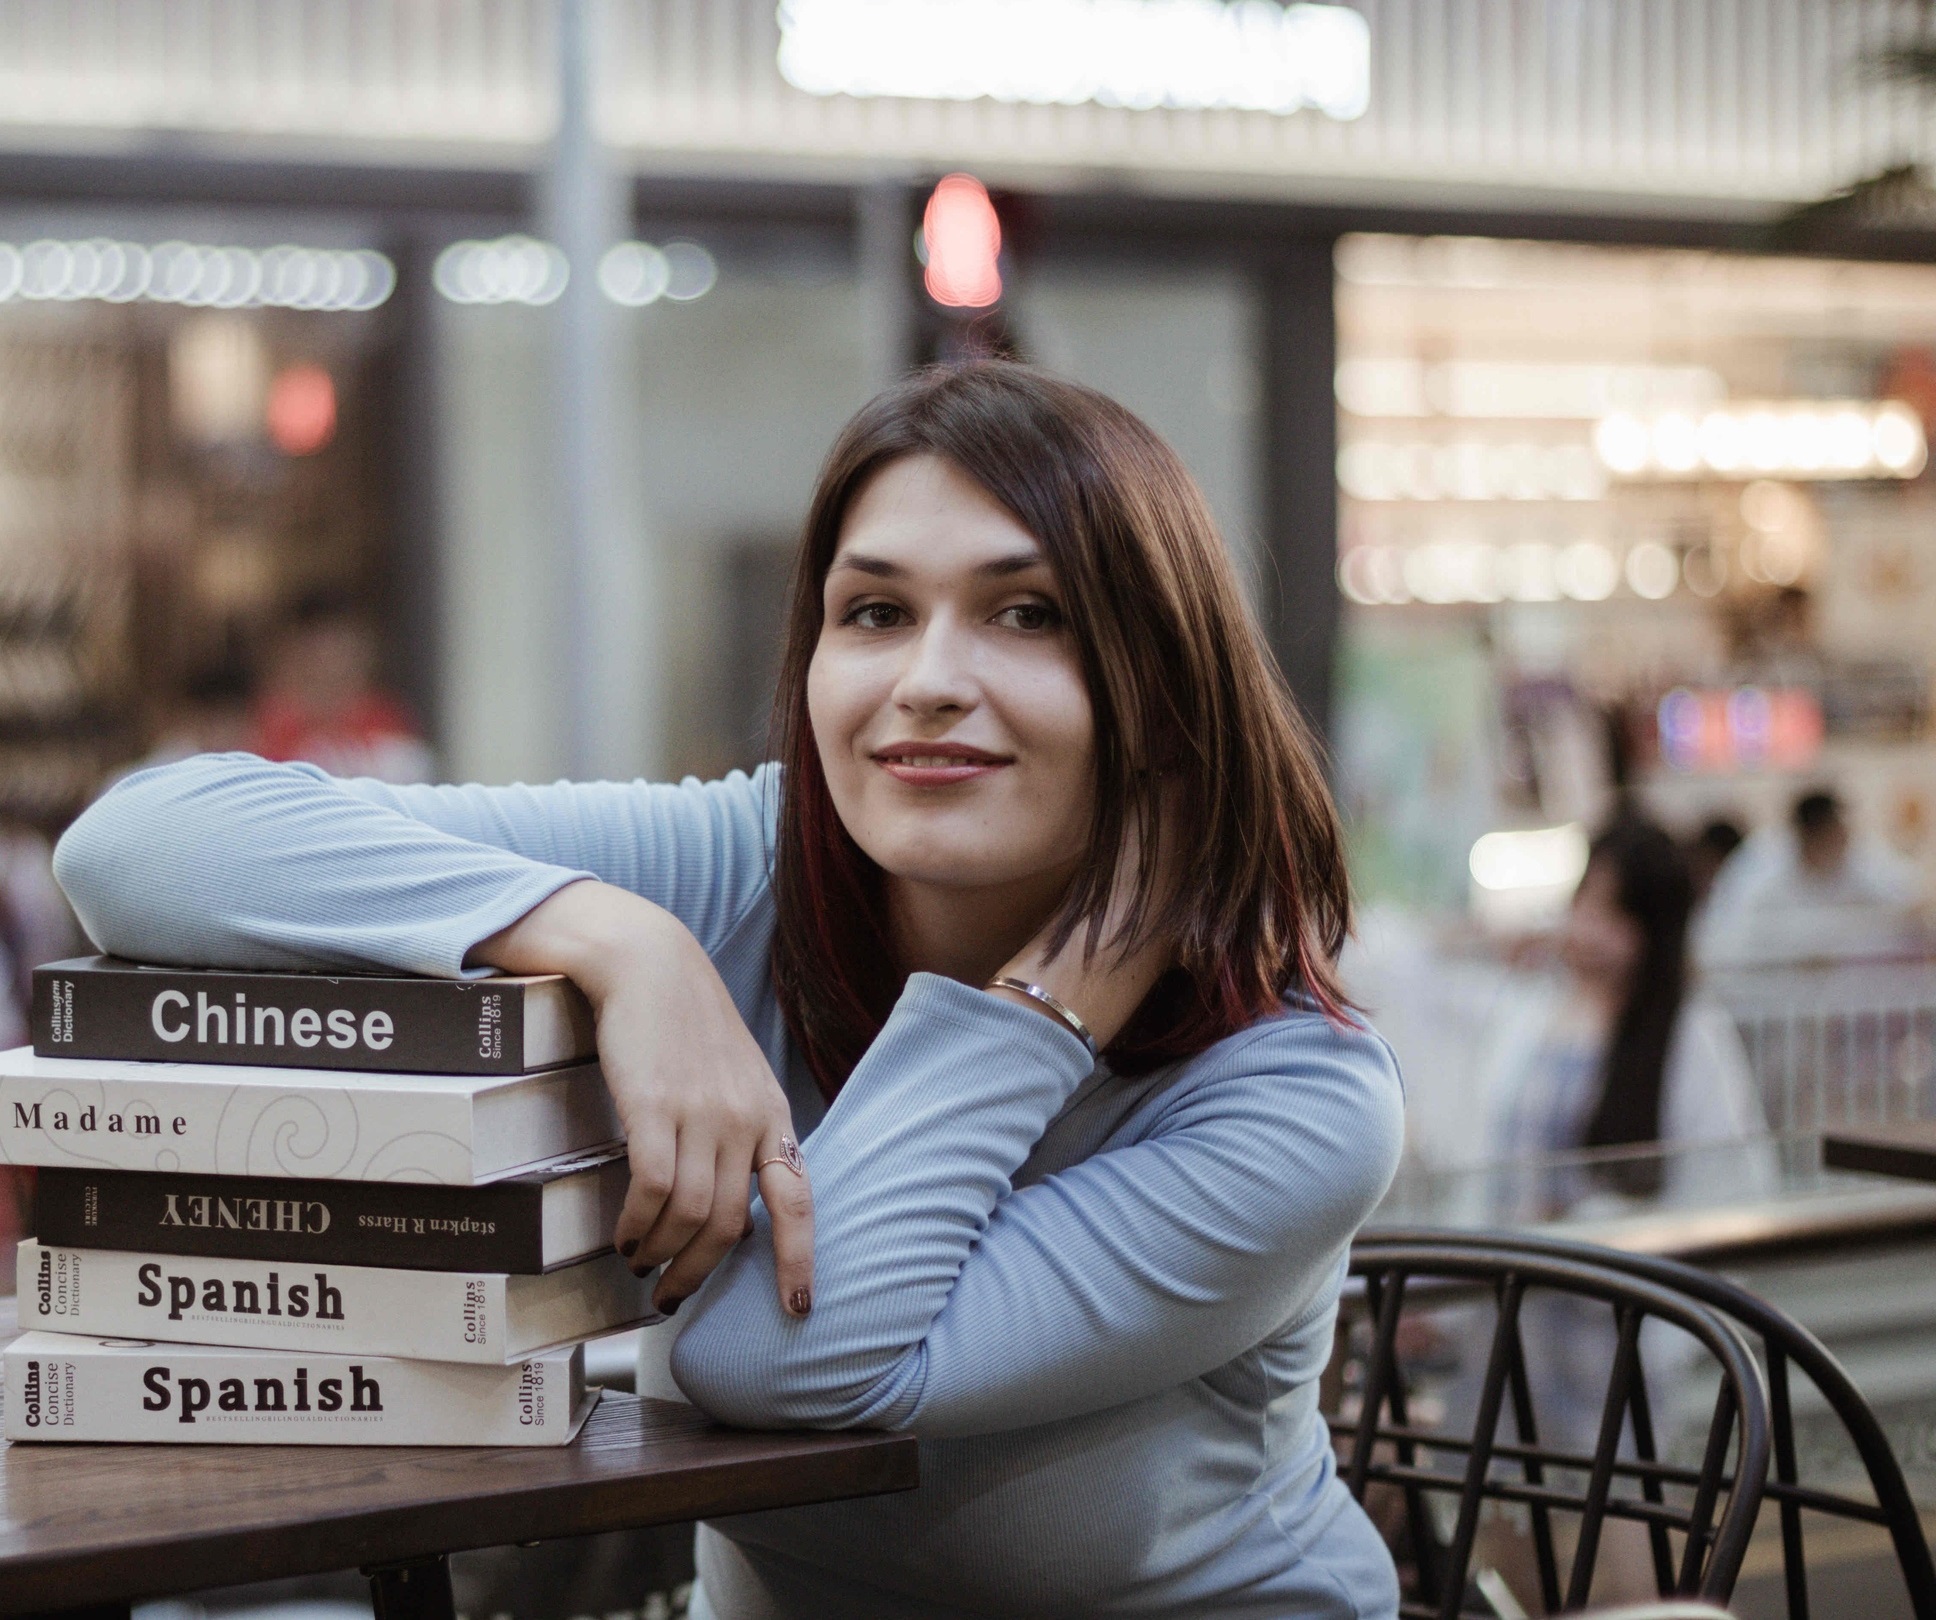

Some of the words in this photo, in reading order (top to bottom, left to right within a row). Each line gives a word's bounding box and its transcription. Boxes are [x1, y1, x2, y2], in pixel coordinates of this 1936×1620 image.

[63, 980, 74, 1042] Dictionary
[152, 990, 394, 1050] Chinese
[479, 996, 491, 1058] Collins
[490, 994, 501, 1024] 1819
[493, 1028, 501, 1059] Since
[13, 1102, 187, 1136] Madame
[159, 1194, 331, 1234] CHENEY
[358, 1215, 408, 1233] Harss
[413, 1218, 426, 1234] R
[38, 1250, 51, 1315] Collins
[55, 1253, 67, 1315] Concise
[70, 1254, 82, 1316] Dictionary
[138, 1263, 345, 1320] Spanish
[474, 1280, 485, 1309] 1819
[464, 1281, 476, 1343] Collins
[477, 1314, 486, 1344] Since
[25, 1360, 40, 1428] Collins
[45, 1362, 59, 1426] Concise
[63, 1362, 76, 1426] Dictionary
[143, 1366, 383, 1423] Spanish
[519, 1363, 533, 1425] Collins
[531, 1362, 544, 1391] 1819
[535, 1395, 544, 1426] Since
